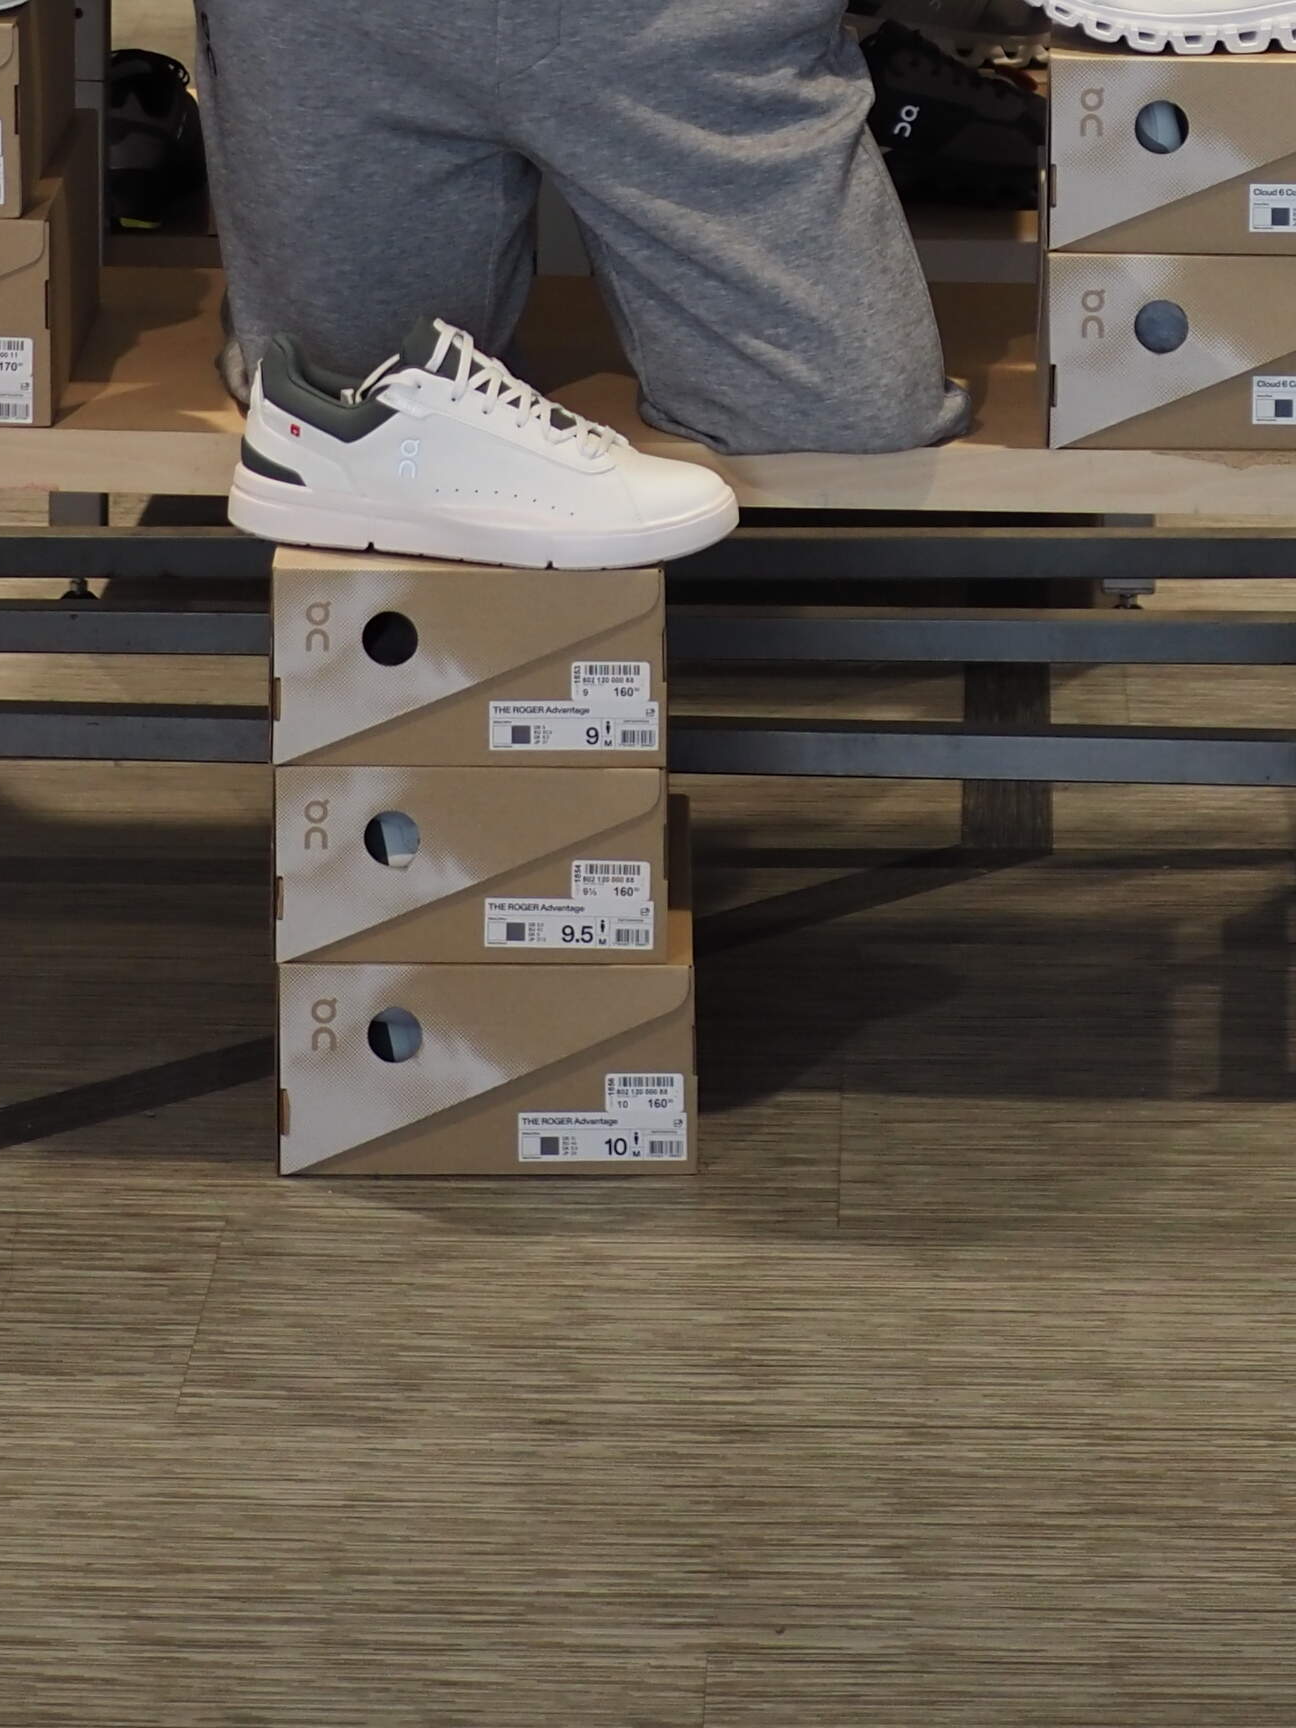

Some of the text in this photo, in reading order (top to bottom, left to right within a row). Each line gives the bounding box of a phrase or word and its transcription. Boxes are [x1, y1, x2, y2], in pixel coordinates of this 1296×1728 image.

[1257, 380, 1281, 388] Cloud
[546, 706, 590, 715] Advantage
[586, 727, 599, 745] 9
[488, 903, 506, 911] THE
[541, 904, 585, 912] Advantage
[562, 925, 593, 943] 9.5
[574, 1118, 618, 1126] Advantage
[605, 1138, 627, 1155] 10
